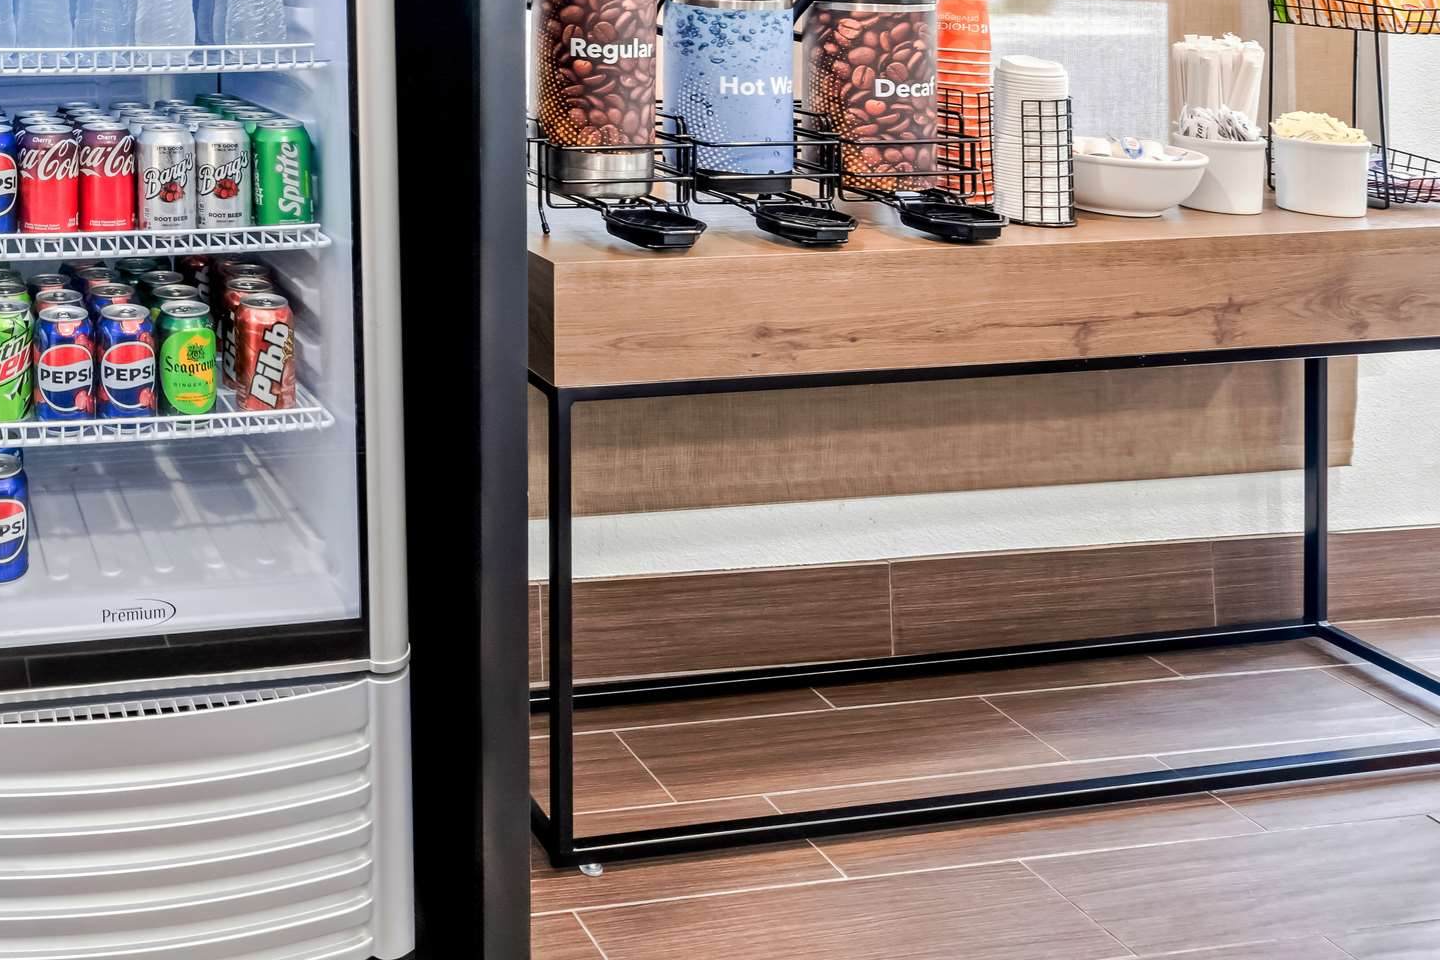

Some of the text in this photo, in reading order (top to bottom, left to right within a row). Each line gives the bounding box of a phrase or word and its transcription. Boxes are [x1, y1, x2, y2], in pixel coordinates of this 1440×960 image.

[570, 37, 654, 64] Regular
[719, 76, 765, 96] Hot
[874, 79, 935, 97] Decaf
[199, 151, 248, 195] Barq's
[278, 142, 305, 216] Sprite
[104, 365, 154, 381] PEPSI
[250, 321, 289, 408] Pibb
[40, 367, 92, 384] PEPSI
[102, 608, 166, 623] Premium
